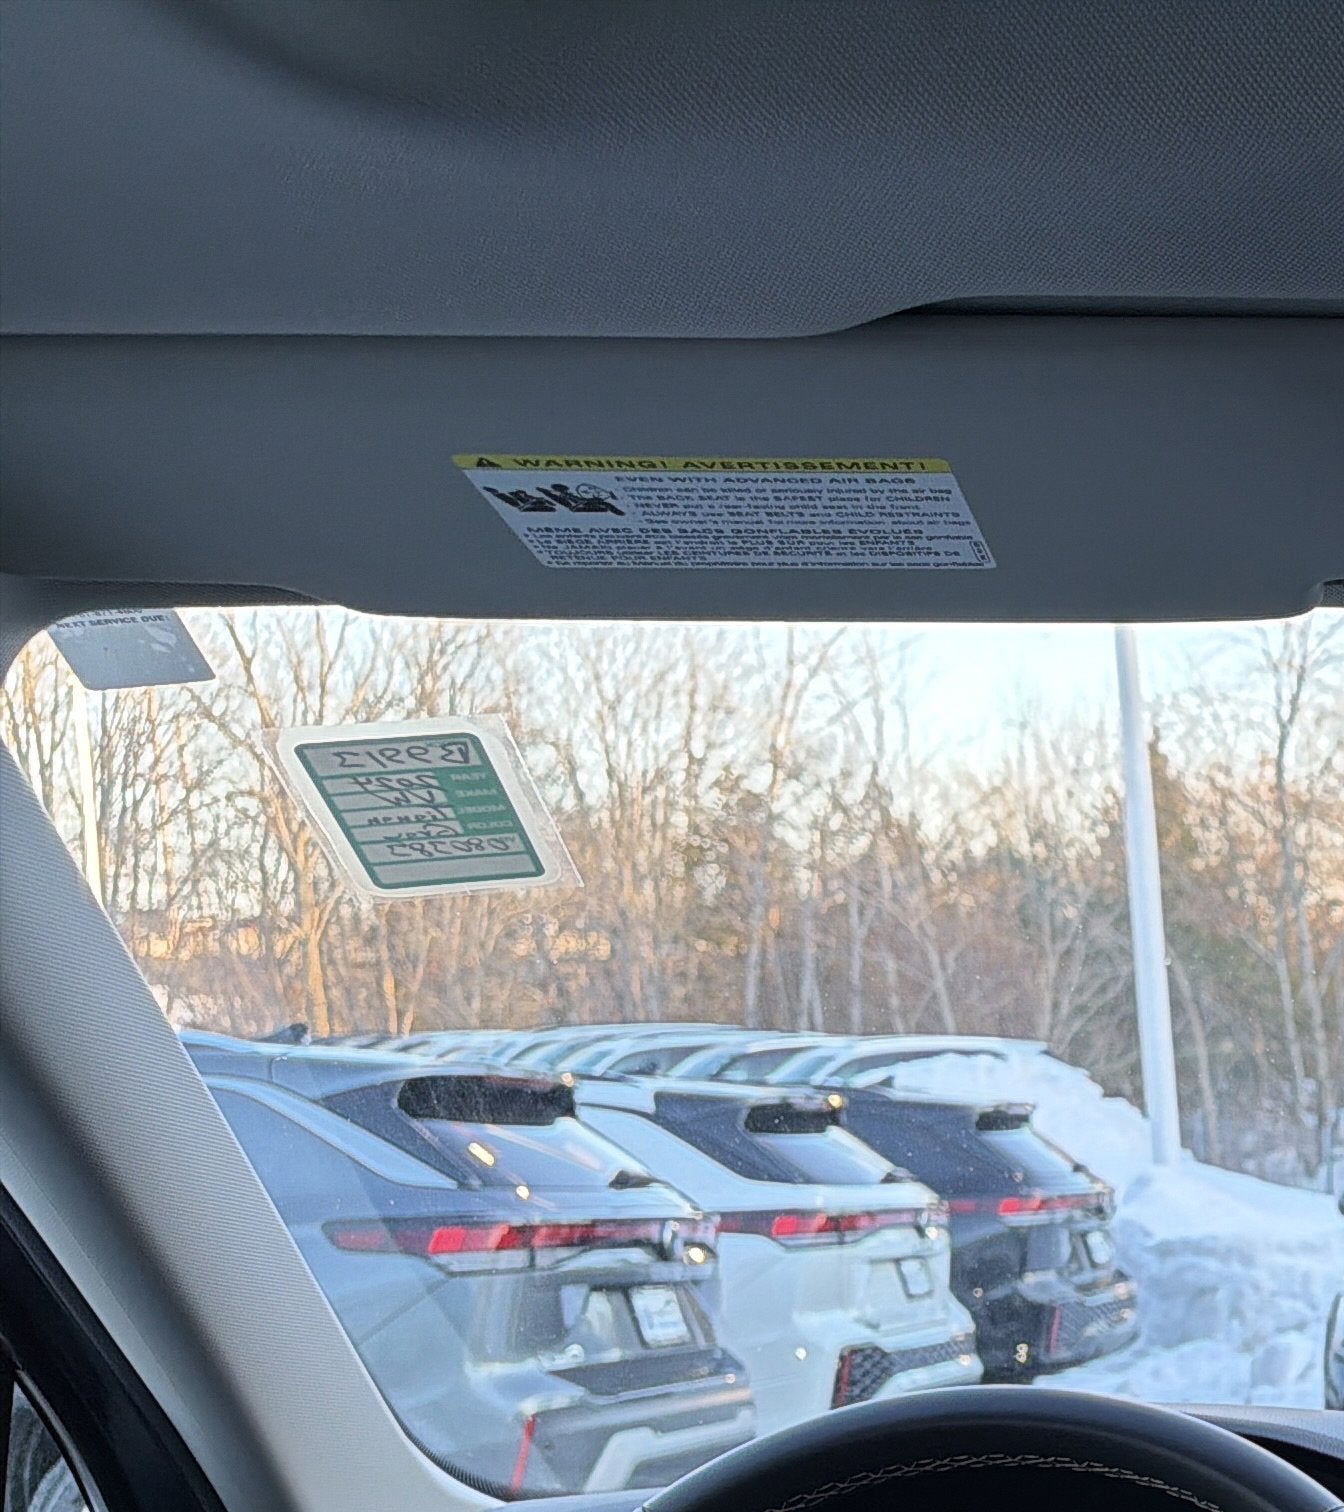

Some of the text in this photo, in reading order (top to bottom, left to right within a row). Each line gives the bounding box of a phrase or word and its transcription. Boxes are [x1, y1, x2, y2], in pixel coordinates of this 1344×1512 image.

[513, 457, 927, 471] WARNING! AVERTISSEMENT!
[89, 616, 138, 627] SERVICE
